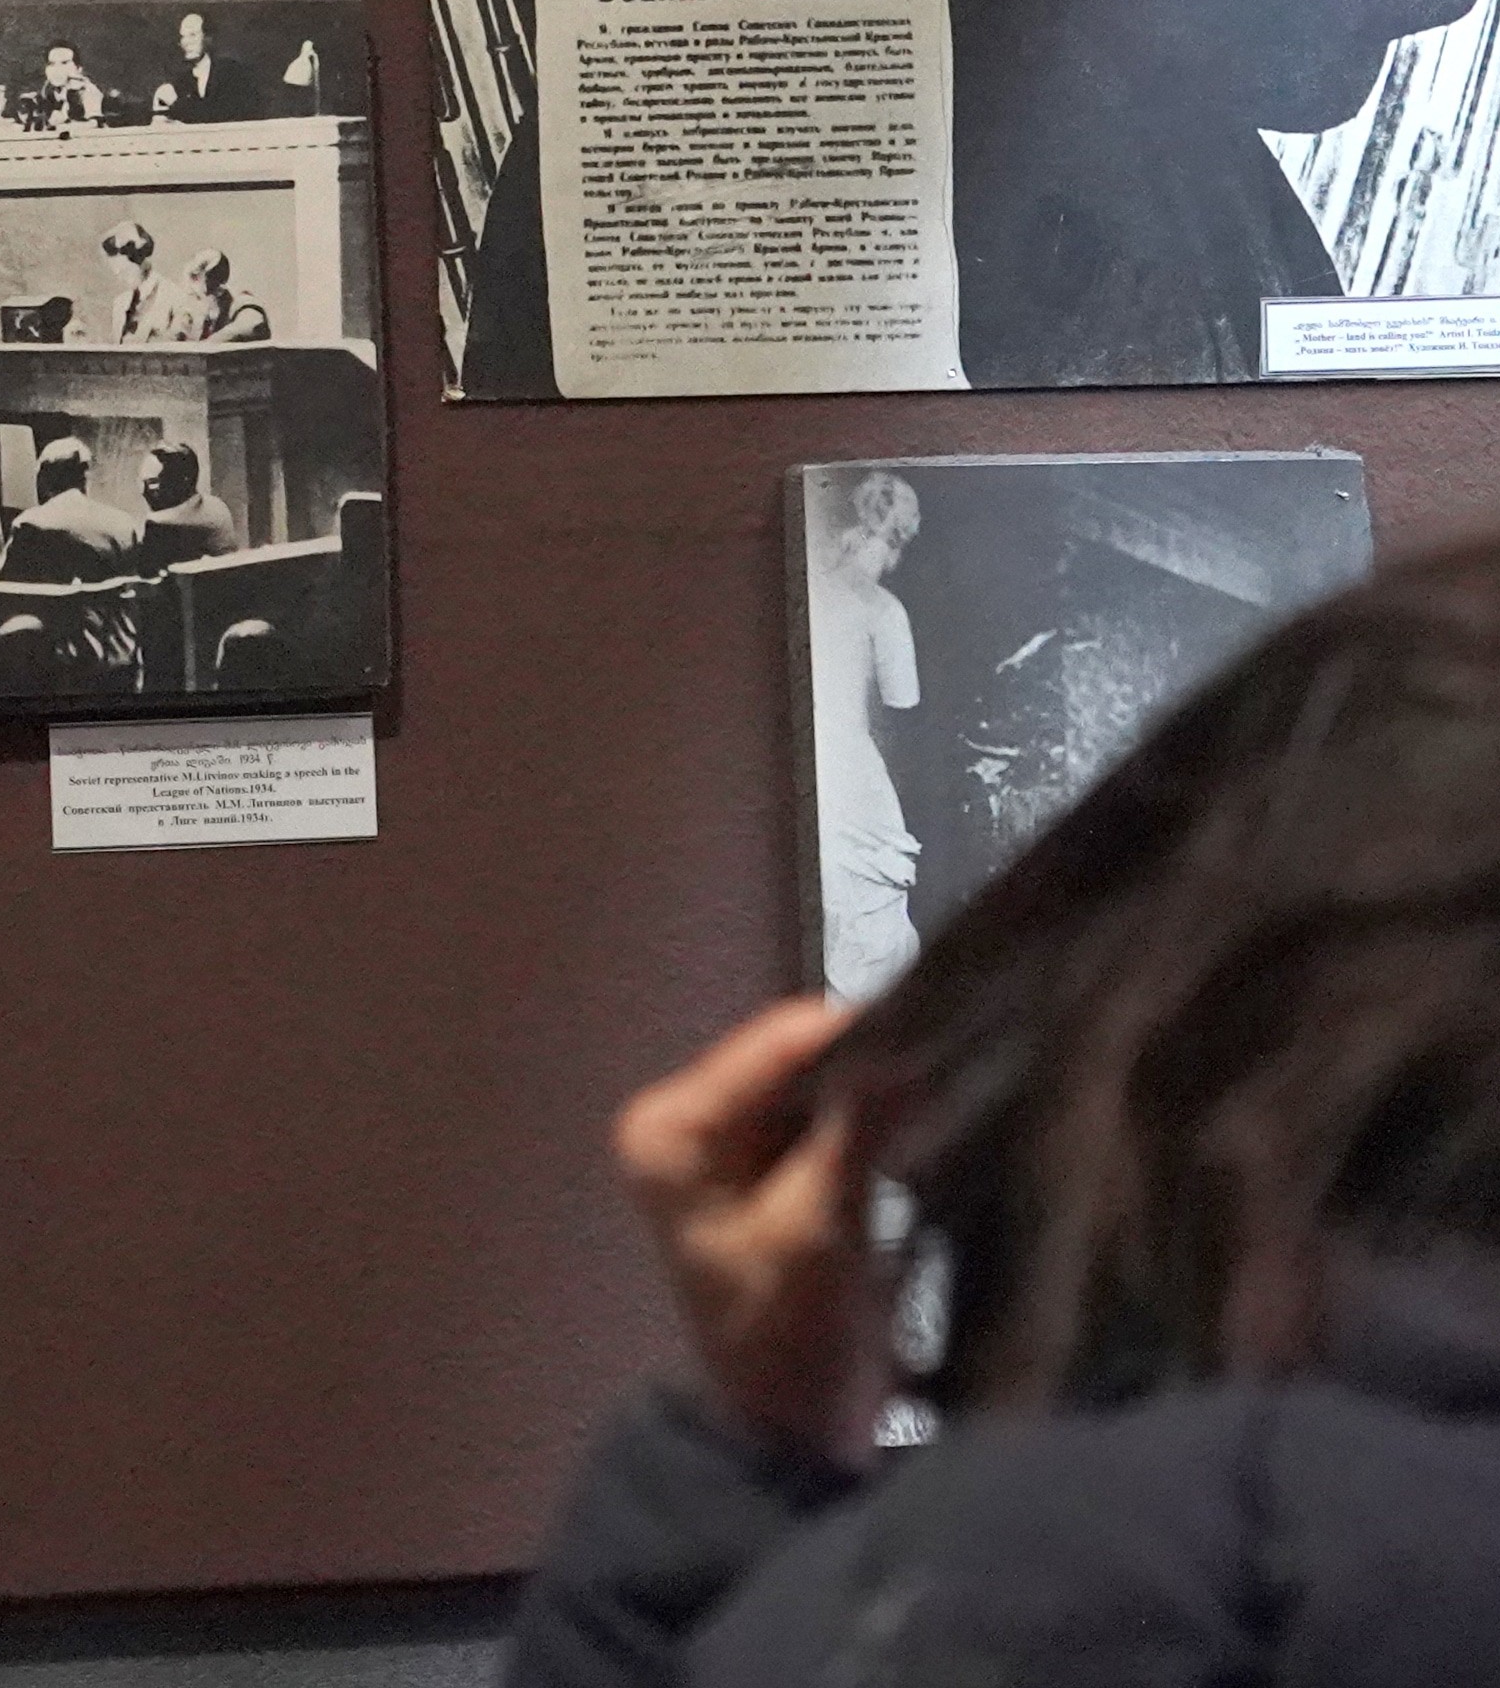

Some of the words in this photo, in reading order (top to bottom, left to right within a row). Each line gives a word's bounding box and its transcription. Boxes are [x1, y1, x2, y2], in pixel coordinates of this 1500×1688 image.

[1303, 333, 1336, 342] Mother
[1346, 332, 1366, 340] land
[1378, 332, 1407, 341] calling
[1440, 330, 1465, 338] Artist
[240, 753, 260, 765] 1934
[69, 775, 100, 786] Soviet
[104, 770, 179, 786] representative
[243, 768, 282, 781] making
[294, 767, 328, 779] speech
[332, 767, 341, 775] in
[344, 766, 360, 776] the
[153, 787, 190, 799] League
[193, 786, 204, 795] of
[62, 804, 122, 816] Советский
[128, 803, 209, 815] представитель
[247, 798, 302, 809] Литвинов
[308, 796, 365, 807] выступает
[158, 818, 164, 826] в
[170, 815, 198, 826] Лиге
